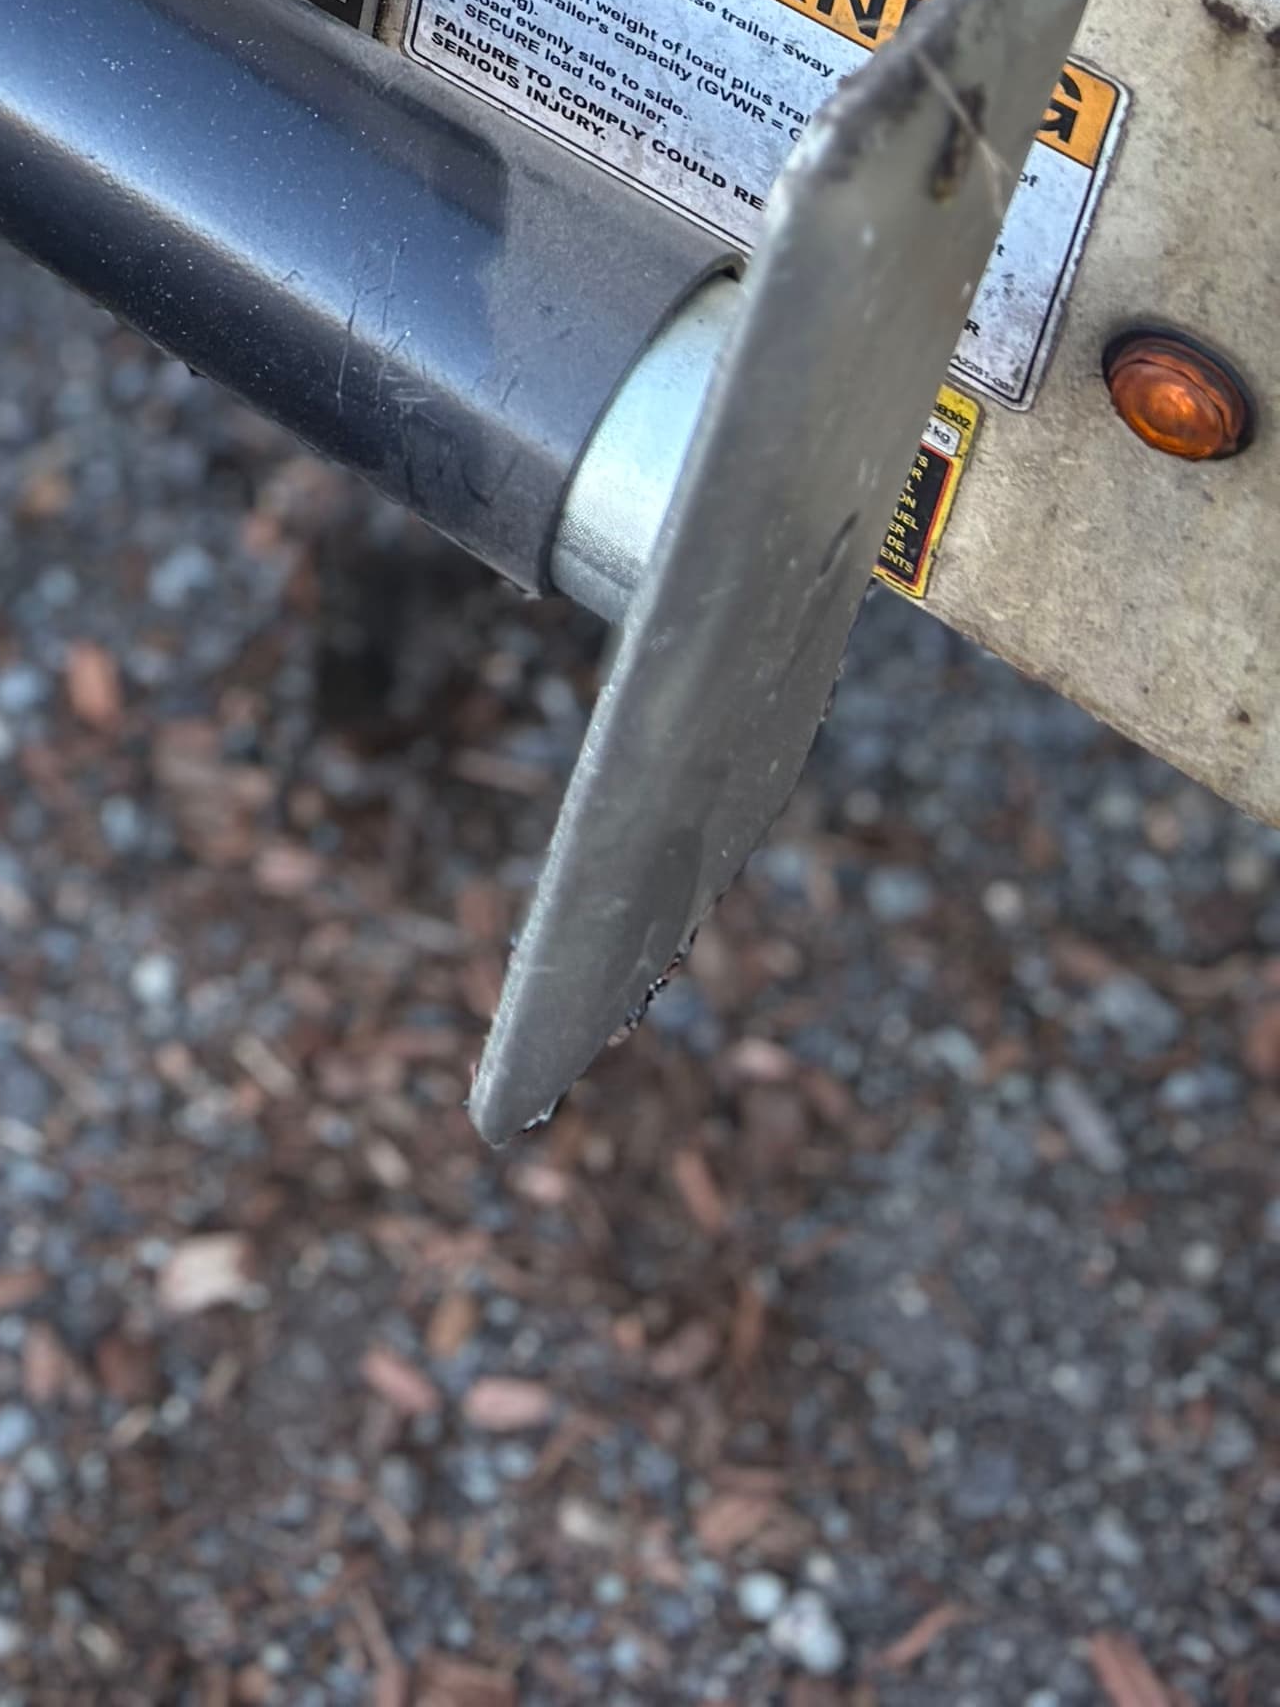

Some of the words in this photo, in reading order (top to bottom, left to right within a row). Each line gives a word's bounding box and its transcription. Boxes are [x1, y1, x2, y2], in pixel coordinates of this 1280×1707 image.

[431, 30, 521, 90] SERIOUS
[525, 84, 607, 141] INJURY.
[463, 2, 541, 56] SECURE
[544, 48, 584, 80] load
[587, 73, 607, 93] to
[610, 86, 668, 128] trailer.
[514, 15, 574, 57] evenly
[577, 50, 617, 79] side
[621, 72, 640, 92] to
[613, 30, 693, 83] capacity
[696, 75, 768, 125] (GVWR
[662, 37, 683, 56] of
[685, 47, 727, 80] load
[730, 76, 773, 108] plus
[721, 6, 782, 46] trailer
[783, 42, 836, 79] sway
[434, 14, 520, 72] FAILURE
[524, 64, 553, 89] TO
[558, 86, 647, 142] COMPLY
[651, 139, 728, 189] COULD
